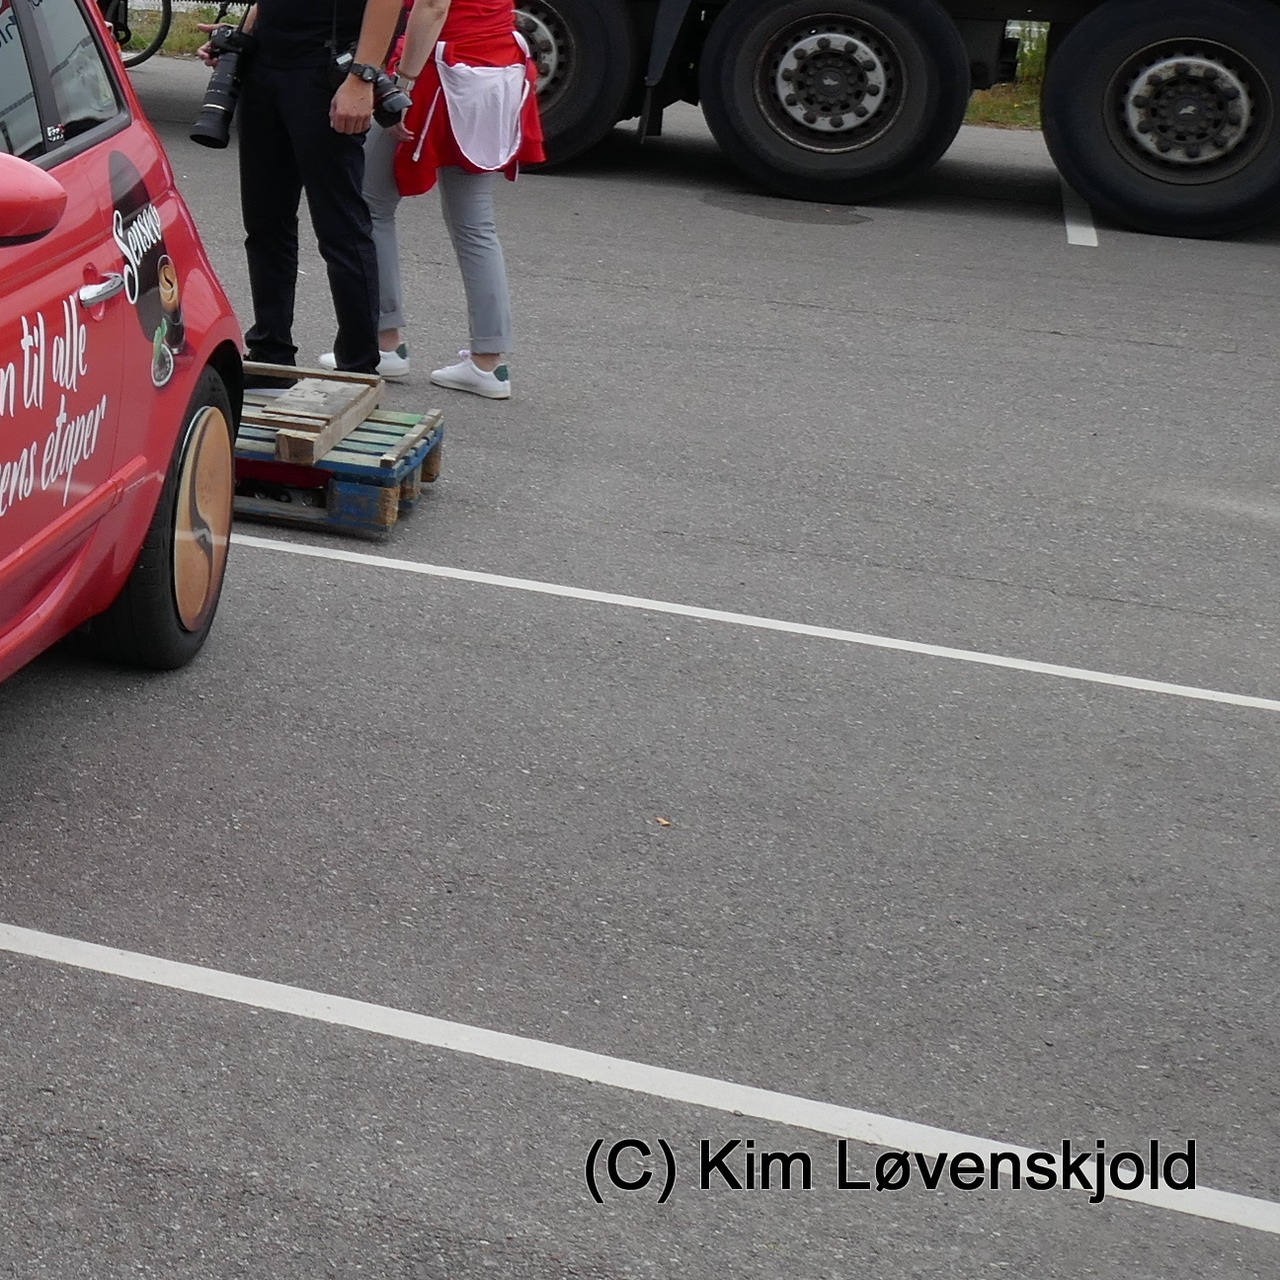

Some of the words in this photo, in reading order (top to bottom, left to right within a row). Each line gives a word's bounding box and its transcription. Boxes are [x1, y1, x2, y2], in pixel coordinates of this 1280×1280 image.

[112, 203, 162, 305] Senseo
[20, 311, 46, 410] til
[52, 294, 88, 392] alle
[41, 393, 107, 507] etaper
